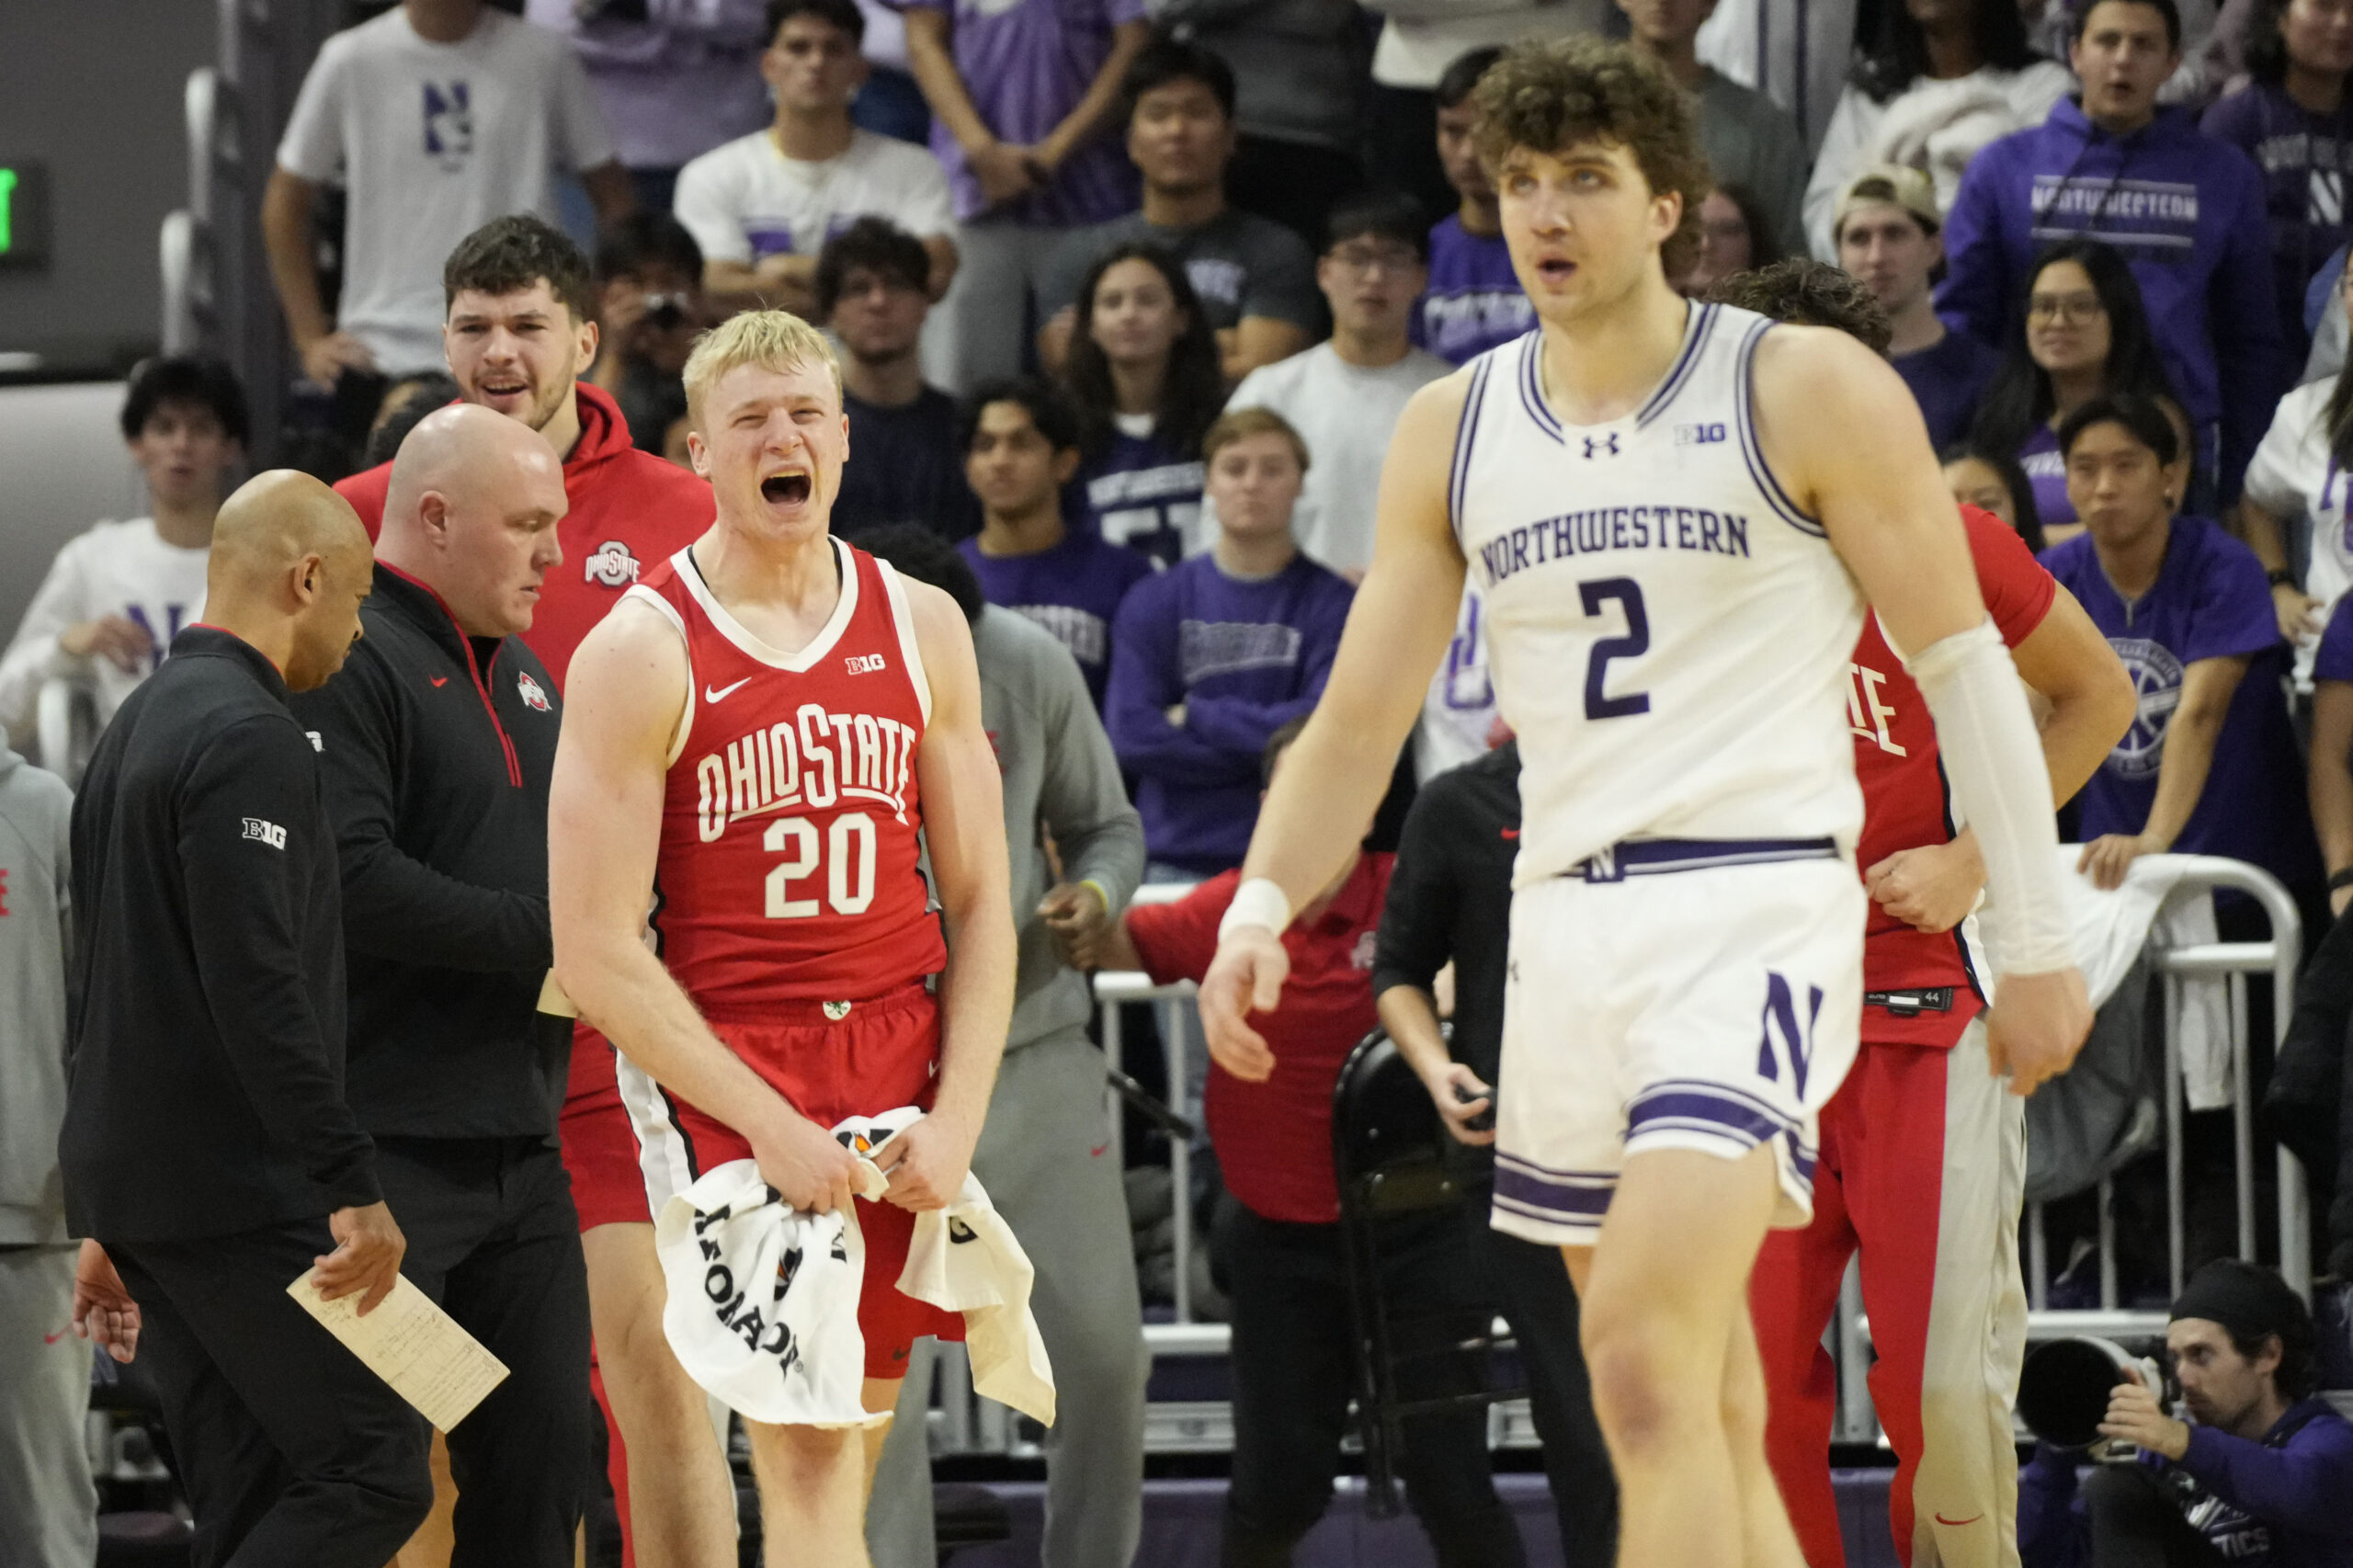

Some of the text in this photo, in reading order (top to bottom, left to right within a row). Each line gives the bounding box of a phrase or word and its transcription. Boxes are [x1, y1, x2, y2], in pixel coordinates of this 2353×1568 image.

[1481, 505, 1750, 589] NORTHWESTERN
[1578, 575, 1651, 721] 2
[763, 812, 877, 919] 20
[1758, 971, 1824, 1103] N
[1925, 992, 1939, 1003] 44
